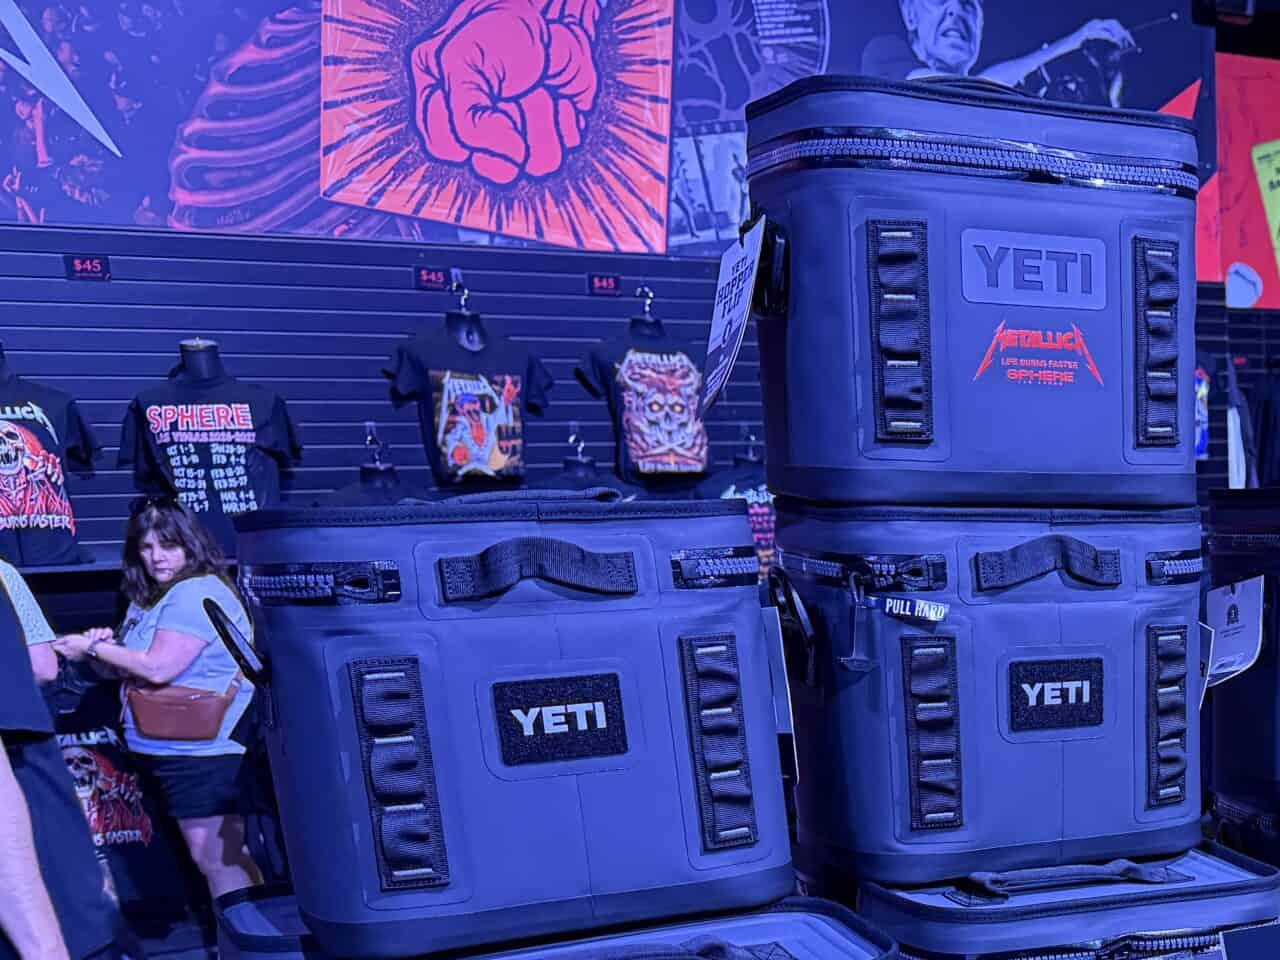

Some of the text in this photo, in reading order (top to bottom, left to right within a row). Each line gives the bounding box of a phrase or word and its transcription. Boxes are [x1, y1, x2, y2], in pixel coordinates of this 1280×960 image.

[73, 258, 101, 272] $45
[972, 244, 1092, 295] YETI
[972, 320, 1104, 387] METALLICA
[1007, 368, 1074, 384] SPHERE
[146, 403, 254, 433] SPHERE
[30, 514, 71, 530] FASTER
[885, 598, 945, 619] PULL HARD
[1021, 679, 1091, 708] YETI
[510, 701, 607, 737] YETI
